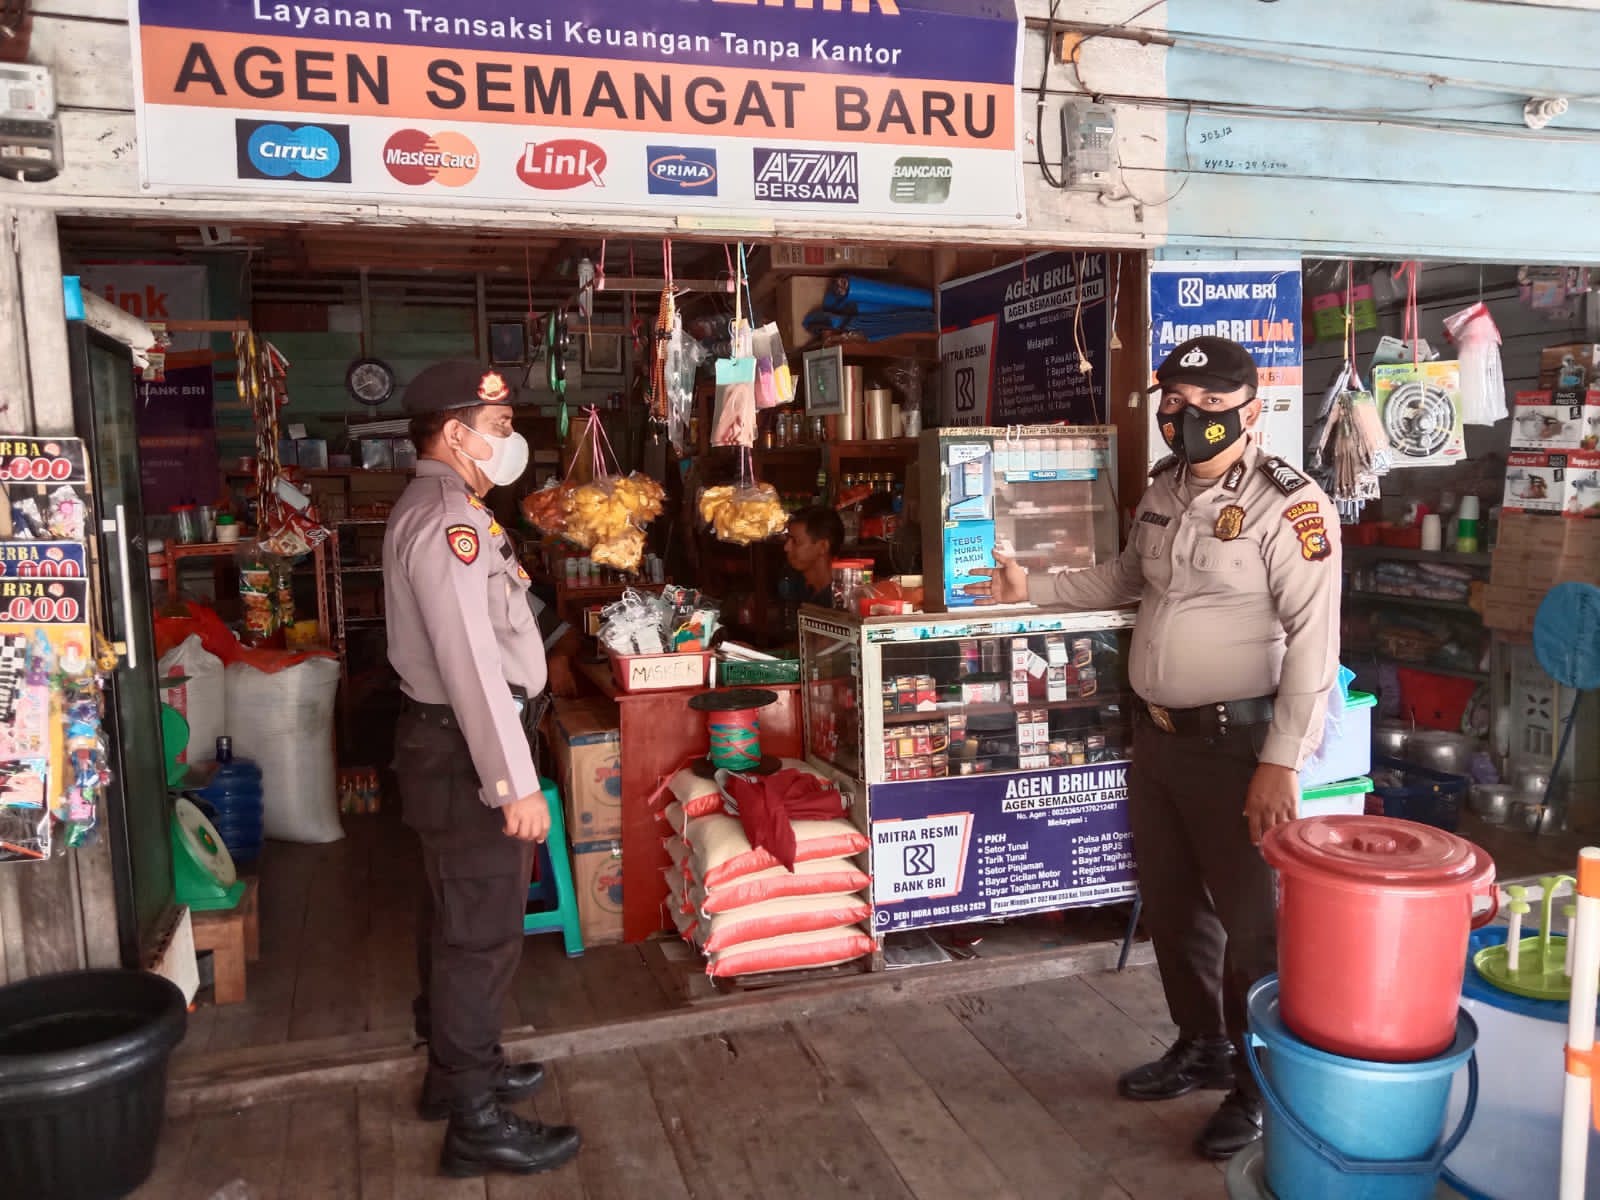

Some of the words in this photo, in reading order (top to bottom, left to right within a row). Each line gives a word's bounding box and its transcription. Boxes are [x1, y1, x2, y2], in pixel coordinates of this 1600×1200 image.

[254, 0, 391, 30] Layanan
[404, 8, 553, 41] Transaksi
[563, 21, 710, 54] Keuangan
[721, 31, 800, 62] Tanpa
[811, 38, 902, 65] Kantor
[173, 42, 389, 104] AGEN
[426, 59, 806, 129] SEMANGAT
[835, 85, 996, 139] BARU
[259, 141, 328, 161] Cirrus
[386, 147, 477, 170] MasterCard
[524, 141, 606, 188] Link
[656, 163, 710, 179] PRIMA
[760, 151, 857, 184] ATM
[891, 164, 952, 179] BANKCARD
[755, 183, 858, 201] BERSAMA
[1005, 274, 1040, 302] AGEN
[1043, 254, 1102, 290] BRILNK
[1205, 284, 1250, 300] BANK
[1252, 283, 1277, 299] BRI
[1159, 319, 1295, 345] AgenBRILink
[181, 385, 206, 397] BRI
[952, 536, 982, 546] TEBUS
[954, 546, 984, 555] MURAH
[956, 554, 984, 564] MAKIN
[1006, 776, 1053, 799] AGEN
[1058, 768, 1128, 793] BRILINK
[1004, 798, 1037, 811] AGEN
[1038, 793, 1097, 807] SEMANGAT
[1100, 788, 1129, 801] BARU
[878, 829, 917, 844] MITRA
[921, 825, 959, 840] RESMI
[984, 833, 1007, 844] PKH
[1101, 833, 1112, 841] All
[984, 844, 1006, 854] Setor
[1008, 842, 1029, 852] Tunai
[1078, 845, 1101, 856] Bayar
[1102, 842, 1124, 851] BPJS
[984, 854, 1005, 865] Tarik
[1007, 852, 1027, 862] Tunai
[1078, 856, 1101, 866] Bayar
[984, 865, 1007, 875] Setor
[1009, 861, 1044, 874] Pinjaman
[1078, 864, 1117, 876] Registrasi
[893, 879, 924, 893] BANK
[927, 876, 946, 889] BRI
[985, 876, 1009, 887] Bayar
[1010, 872, 1038, 882] Cicilan
[1038, 869, 1061, 879] Motor
[1080, 875, 1106, 885] T-Bank
[985, 886, 1009, 897] Bayar
[1010, 882, 1041, 894] Tagihan
[1042, 880, 1059, 889] PLN
